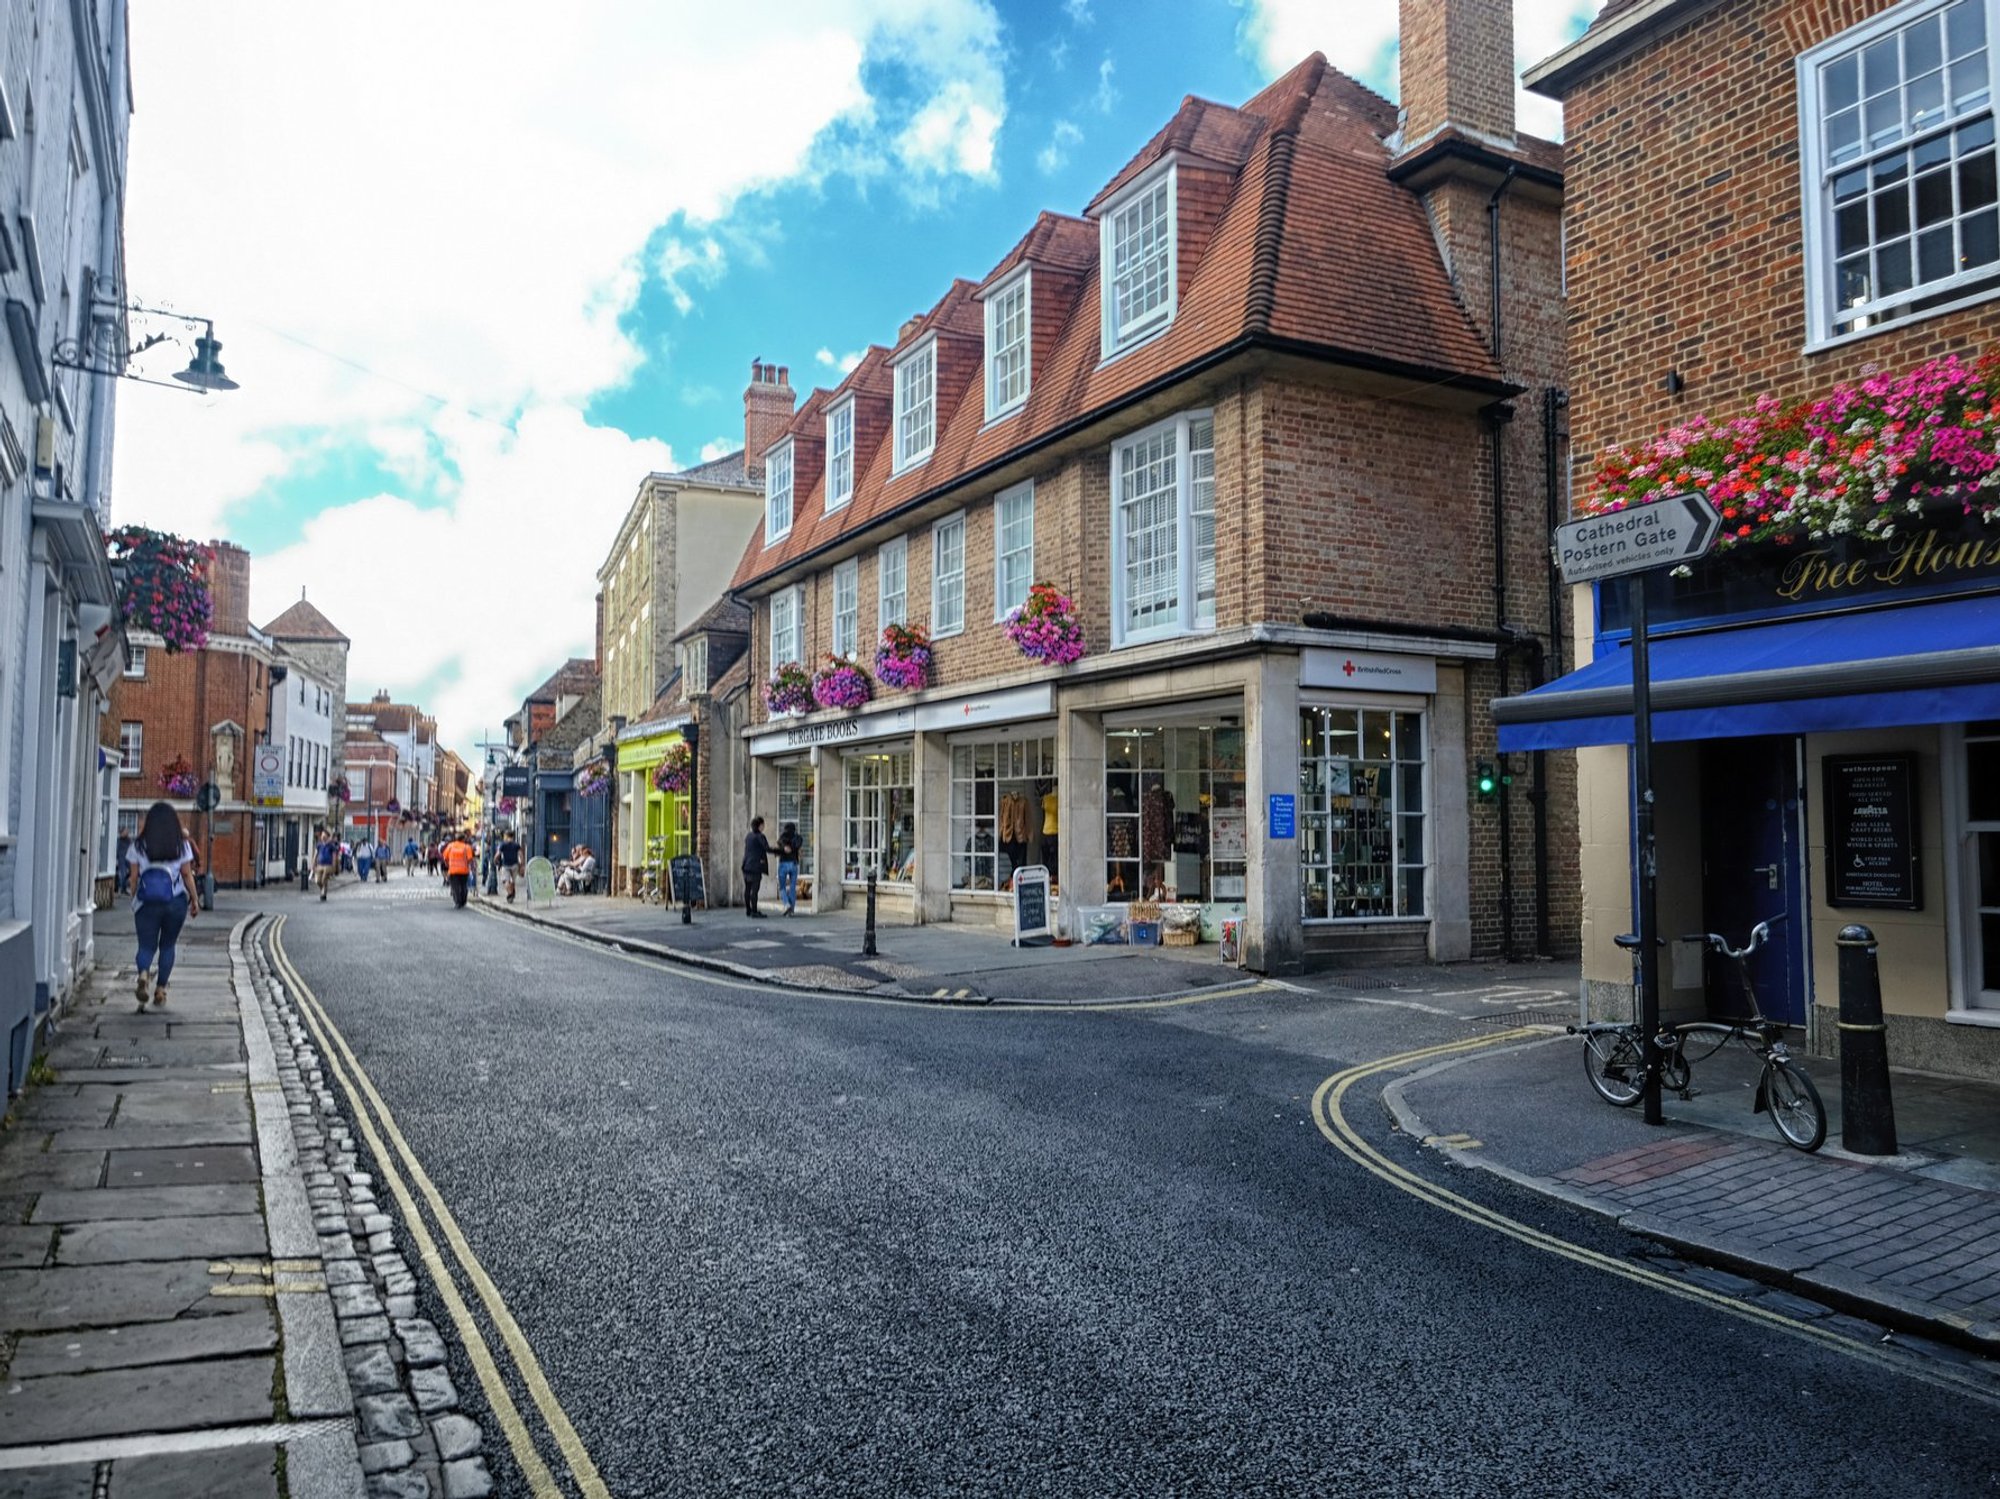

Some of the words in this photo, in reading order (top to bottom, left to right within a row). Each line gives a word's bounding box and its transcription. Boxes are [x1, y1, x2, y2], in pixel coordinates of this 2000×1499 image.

[1576, 510, 1660, 543] Cathedral
[1563, 540, 1627, 564] Postern
[1635, 527, 1677, 547] Gate
[1567, 559, 1613, 577] Authorised
[1616, 551, 1652, 565] vehicles
[1654, 545, 1675, 556] only
[1776, 546, 1868, 600] Free
[787, 725, 825, 747] BURGATE
[826, 719, 859, 741] BOOKS
